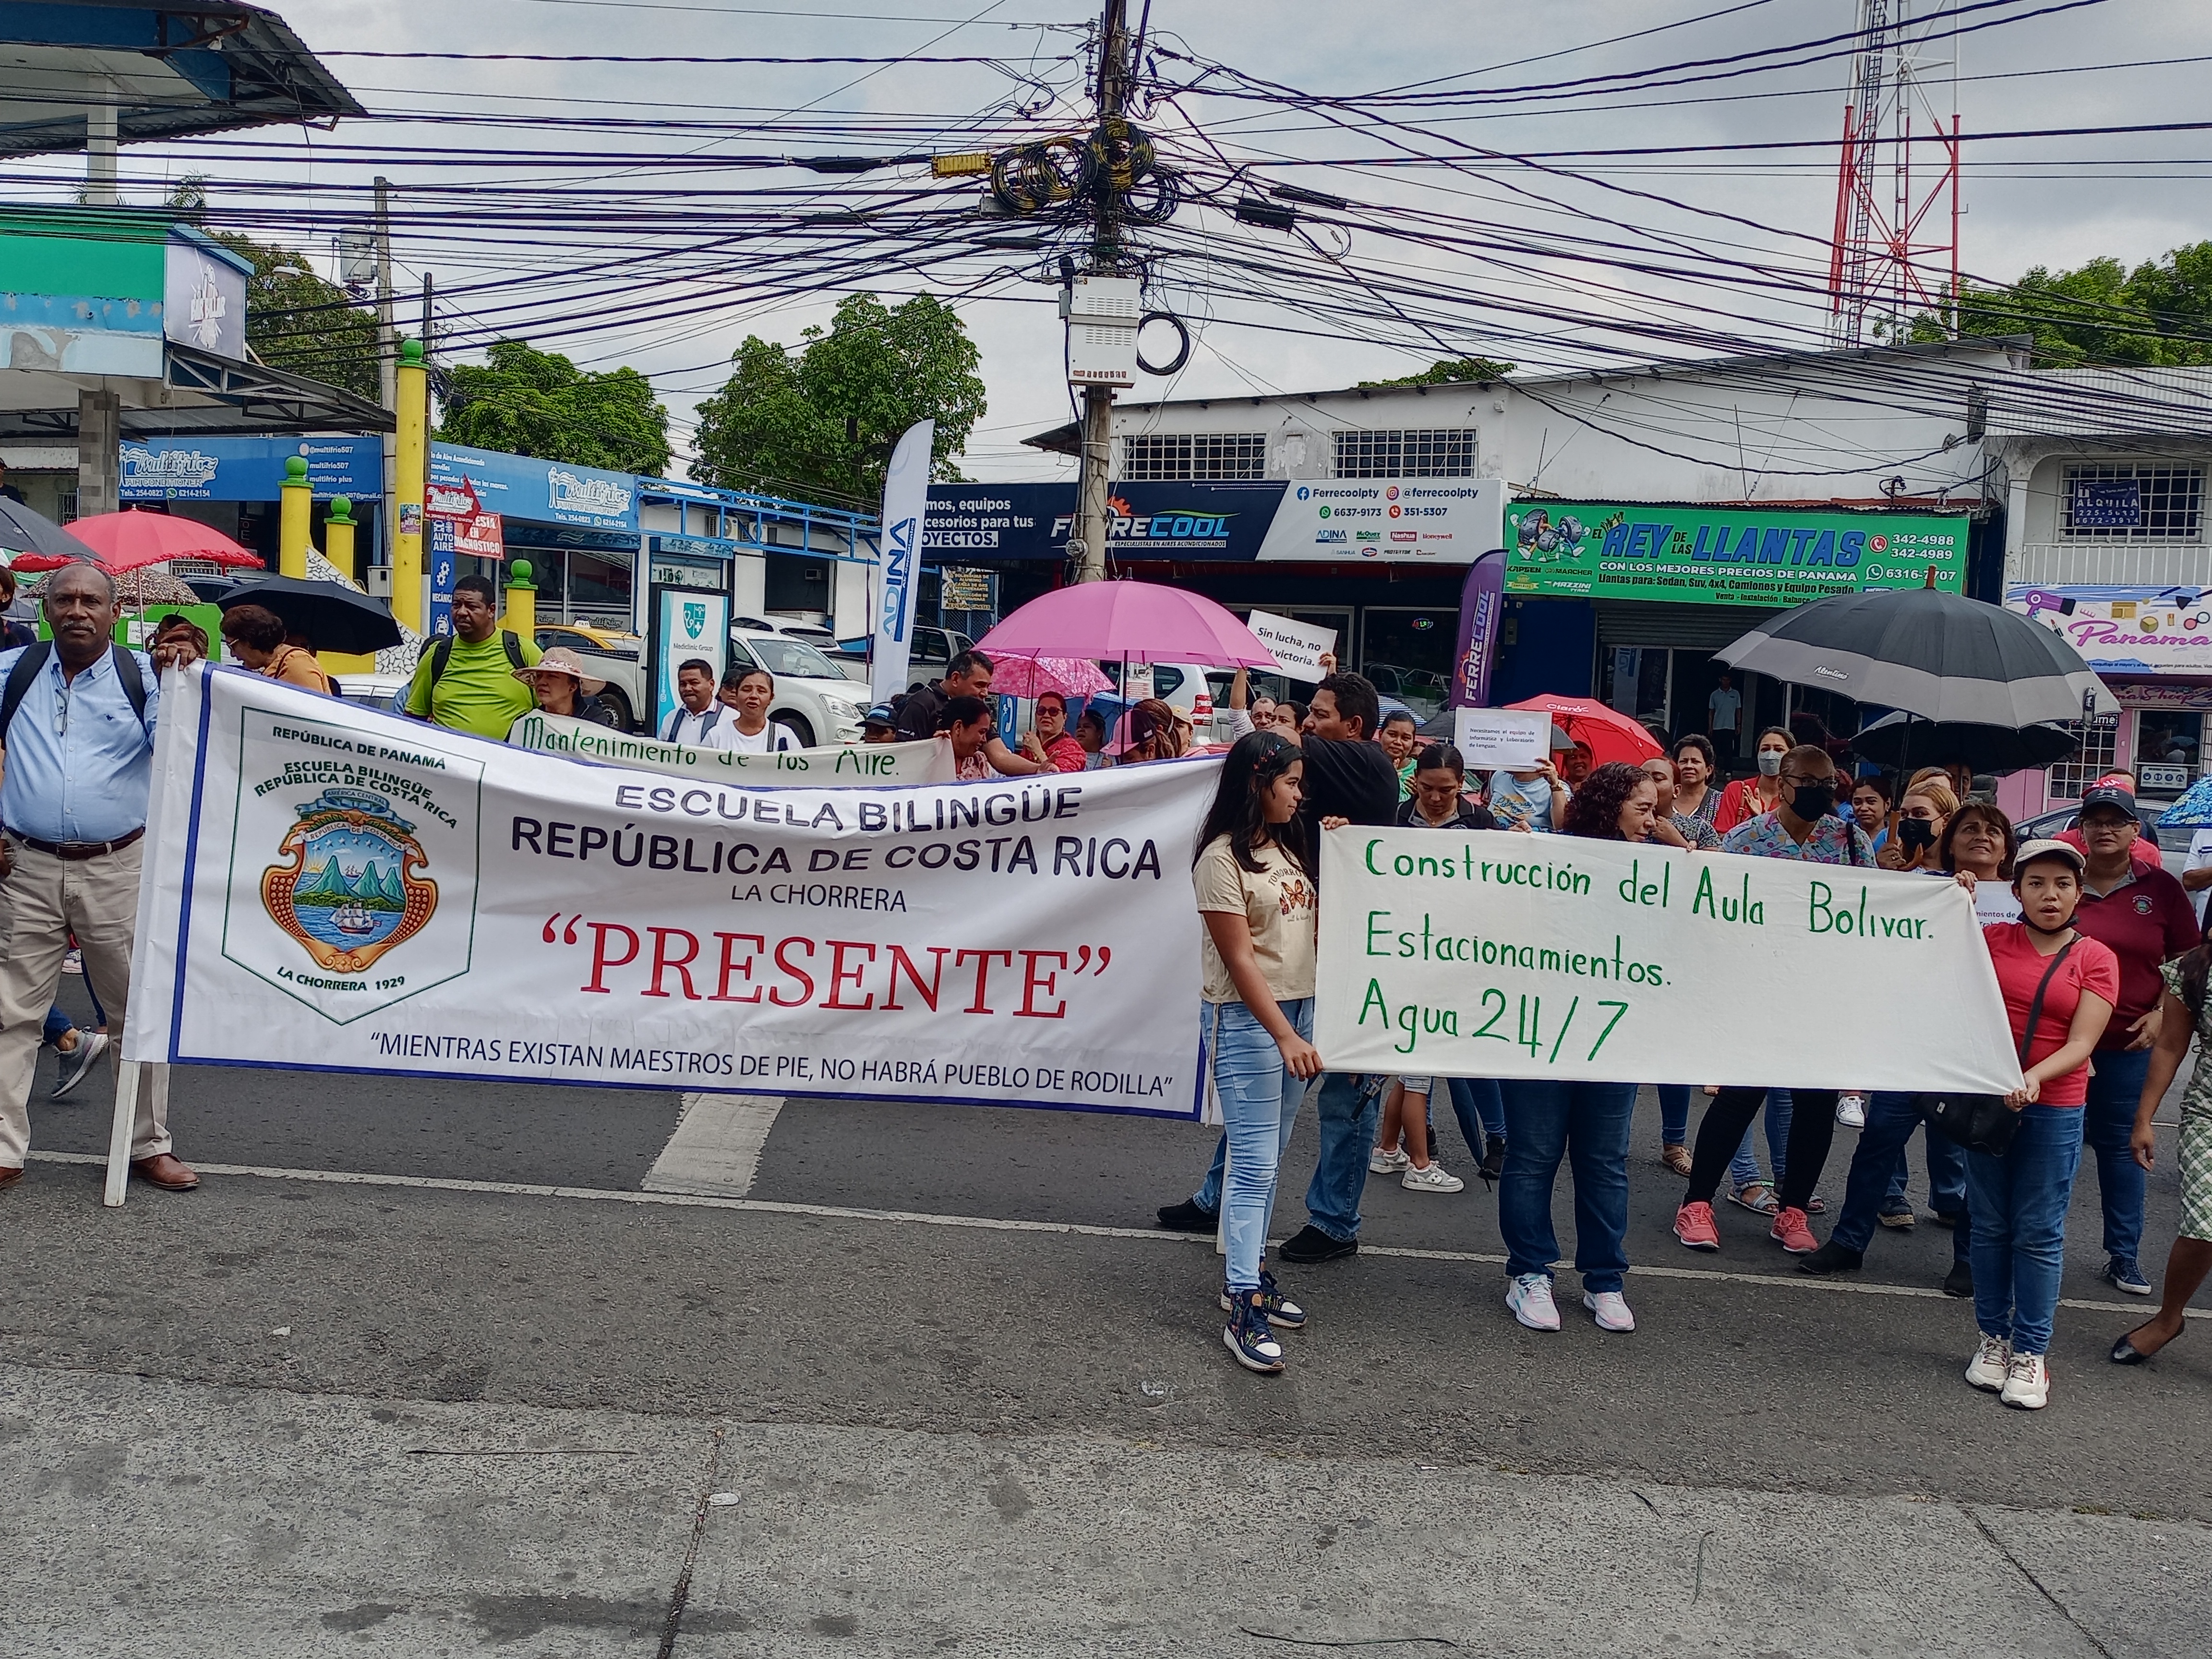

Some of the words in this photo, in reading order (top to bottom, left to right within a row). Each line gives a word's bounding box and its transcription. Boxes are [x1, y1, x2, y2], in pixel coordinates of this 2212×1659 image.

[338, 476, 352, 484] plus
[1313, 488, 1379, 499] Ferrecoolpty
[1402, 487, 1479, 499] @ferrecoolpty
[2076, 498, 2138, 507] ALQUILA
[926, 500, 955, 513] mos,
[959, 497, 1011, 513] equipos
[1334, 508, 1382, 517] 6637-9173
[1404, 507, 1448, 517] 351-5307
[924, 515, 977, 528] cesorios
[981, 517, 1010, 530] para
[1013, 516, 1034, 528] tus
[433, 532, 454, 541] AUTO
[922, 532, 998, 546] OYECTOS.
[1317, 530, 1347, 539] ADINA
[1592, 529, 1603, 539] EL
[1600, 522, 1674, 559] REY
[1673, 531, 1687, 542] DE
[1892, 534, 1954, 546] 342-4988
[433, 541, 454, 552] AIRE
[1671, 543, 1693, 554] LAS
[1690, 525, 1866, 567] LLANTAS
[1890, 548, 1953, 560] 342-4989
[883, 517, 909, 636] ADINA
[1599, 562, 1626, 571] CON
[1629, 563, 1653, 572] LOS
[1656, 564, 1715, 575] MEJORES
[1718, 567, 1774, 577] PRECIOS
[1777, 569, 1795, 579] DE
[1798, 570, 1858, 581] PANAMA
[1552, 581, 1592, 589] MAZZINI
[1599, 574, 1630, 584] Llantas
[1632, 576, 1656, 585] para:
[1657, 577, 1687, 588] Sedan,
[1689, 577, 1707, 589] Suv,
[1708, 579, 1727, 589] 4x4,
[1729, 579, 1776, 592] Camiones
[1777, 583, 1783, 592] y
[1784, 582, 1816, 594] Equipo
[1818, 584, 1854, 594] Pesado
[1257, 627, 1273, 639] Sin
[1275, 631, 1305, 649] lucha,
[1307, 642, 1321, 651] no
[2068, 620, 2212, 647] Panama
[698, 644, 713, 652] Group
[1465, 590, 1489, 701] FERRECOOL
[1275, 649, 1315, 667] victoria.
[1546, 703, 1582, 713] Claro
[273, 726, 353, 752] REPÚBLICA
[357, 743, 376, 756] DE
[380, 747, 446, 769] PANAMÁ
[522, 716, 697, 767] Mantenimiento
[717, 749, 750, 768] de
[834, 748, 901, 777] Aire.
[284, 760, 354, 775] ESCUELA
[358, 765, 433, 799] BILINGÜE
[344, 775, 365, 787] DE
[369, 780, 420, 806] COSTA
[423, 800, 457, 829] RICA
[357, 792, 385, 805] CENTRAL
[615, 784, 843, 831] ESCUELA
[858, 783, 1082, 833] BILINGÜE
[365, 826, 387, 840] COSTA
[387, 837, 402, 849] RICA
[511, 816, 792, 875] REPÚBLICA
[807, 847, 873, 872] DE
[884, 835, 1038, 875] COSTA
[1053, 835, 1161, 880] RICA
[1268, 868, 1306, 887] TOMORRO
[1365, 839, 1591, 895] Construcción
[1619, 859, 1670, 908] del
[1692, 866, 1764, 926] Aula
[731, 884, 763, 902] LA
[770, 883, 907, 913] CHORRERA
[1366, 911, 1671, 986] Estacionamientos.
[542, 912, 1112, 1019] “PRESENTE”
[276, 965, 293, 981] LA
[296, 974, 367, 991] CHORRERA
[375, 975, 406, 990] 1929
[1358, 977, 1458, 1053] Agua
[1472, 988, 1629, 1064] 24/7
[508, 1040, 604, 1067] EXISTAN
[609, 1047, 733, 1075] MAESTROS
[740, 1054, 770, 1077] DE
[776, 1056, 814, 1082] PIE,
[820, 1058, 856, 1081] NO
[863, 1058, 938, 1085] HABRÁ
[945, 1064, 1030, 1089] PUEBLO
[1036, 1069, 1065, 1091] DE
